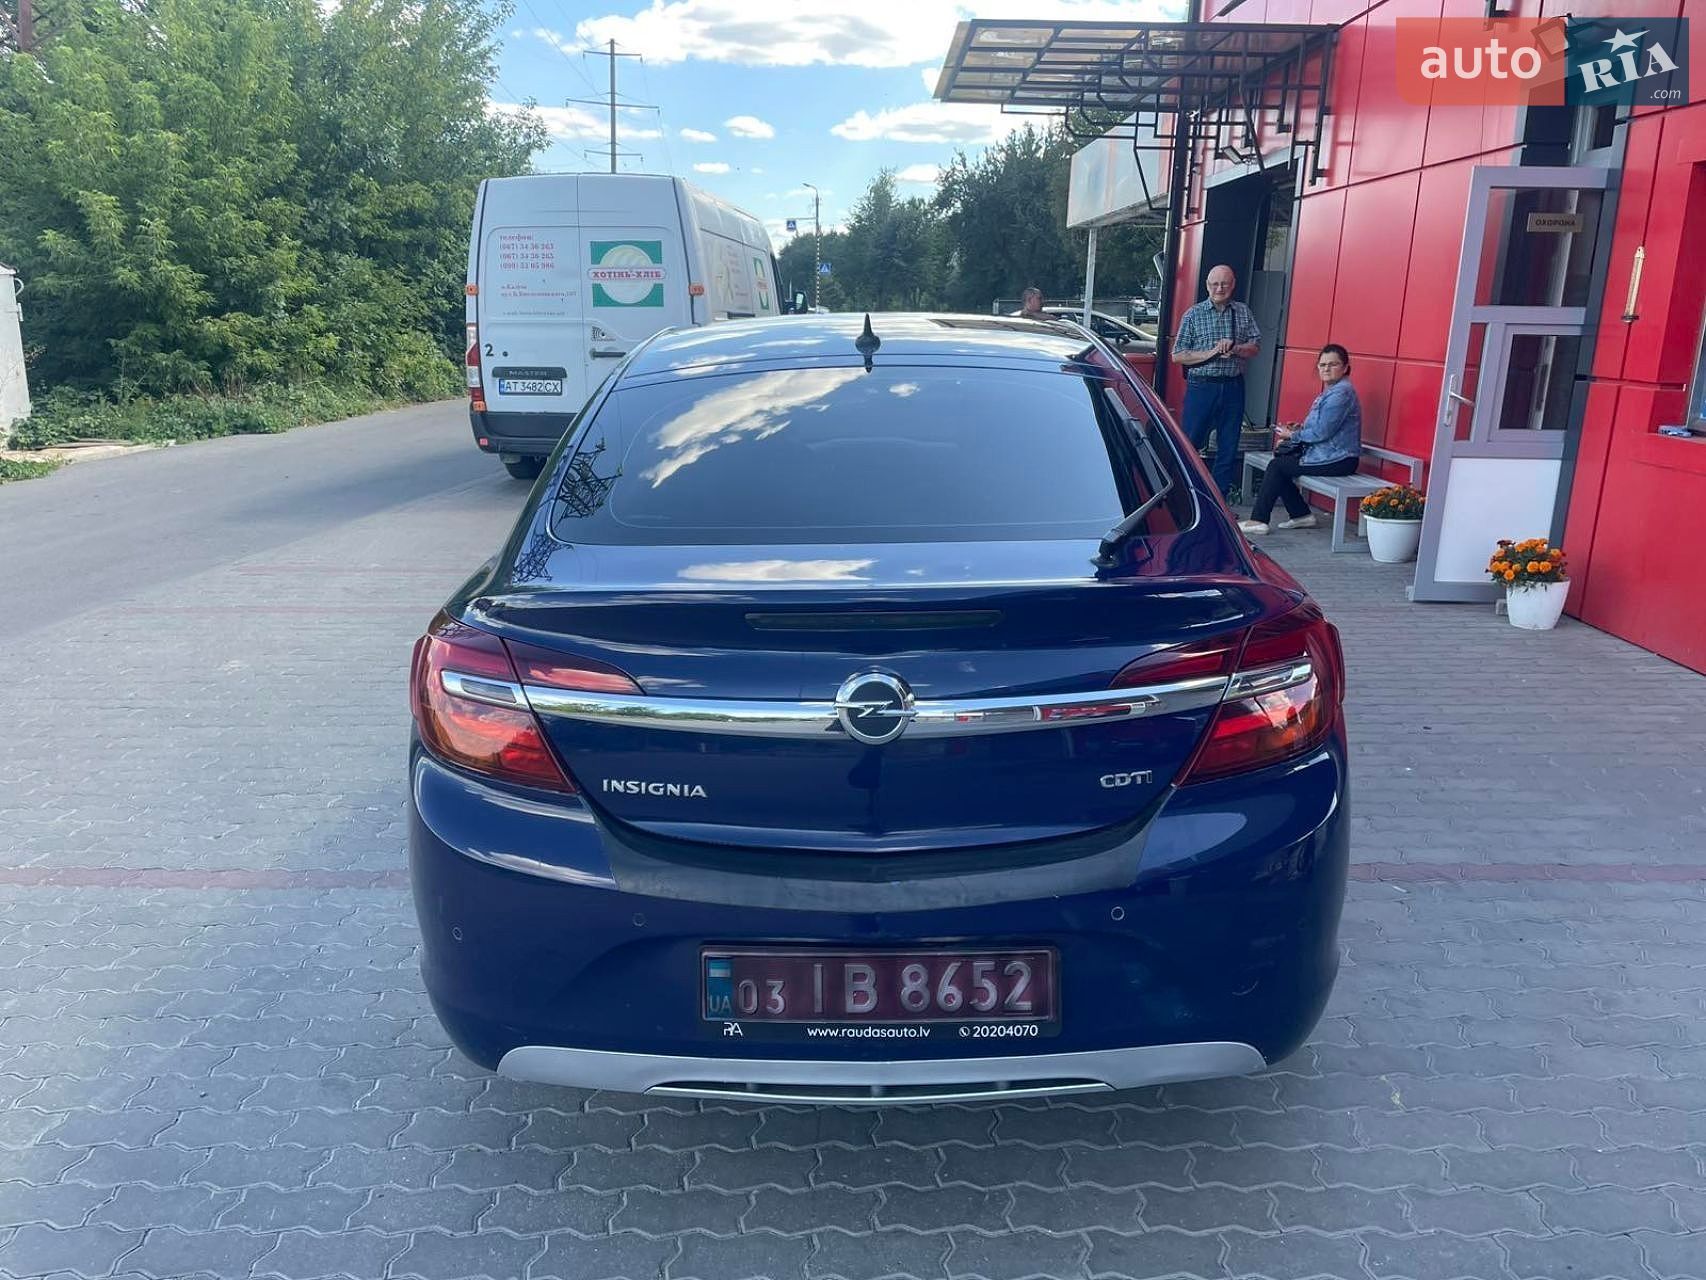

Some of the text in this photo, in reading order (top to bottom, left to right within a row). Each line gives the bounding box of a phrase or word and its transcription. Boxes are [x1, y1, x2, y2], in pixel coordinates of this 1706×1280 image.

[484, 343, 494, 357] 2
[506, 381, 560, 393] AT 3482 CX
[602, 778, 708, 798] INSIGNIA
[738, 978, 785, 1015] 03
[900, 960, 1033, 1013] 8652
[708, 995, 732, 1014] UA
[807, 1025, 931, 1038] www.raudasauto.lv
[972, 1024, 1039, 1038] 20204070
